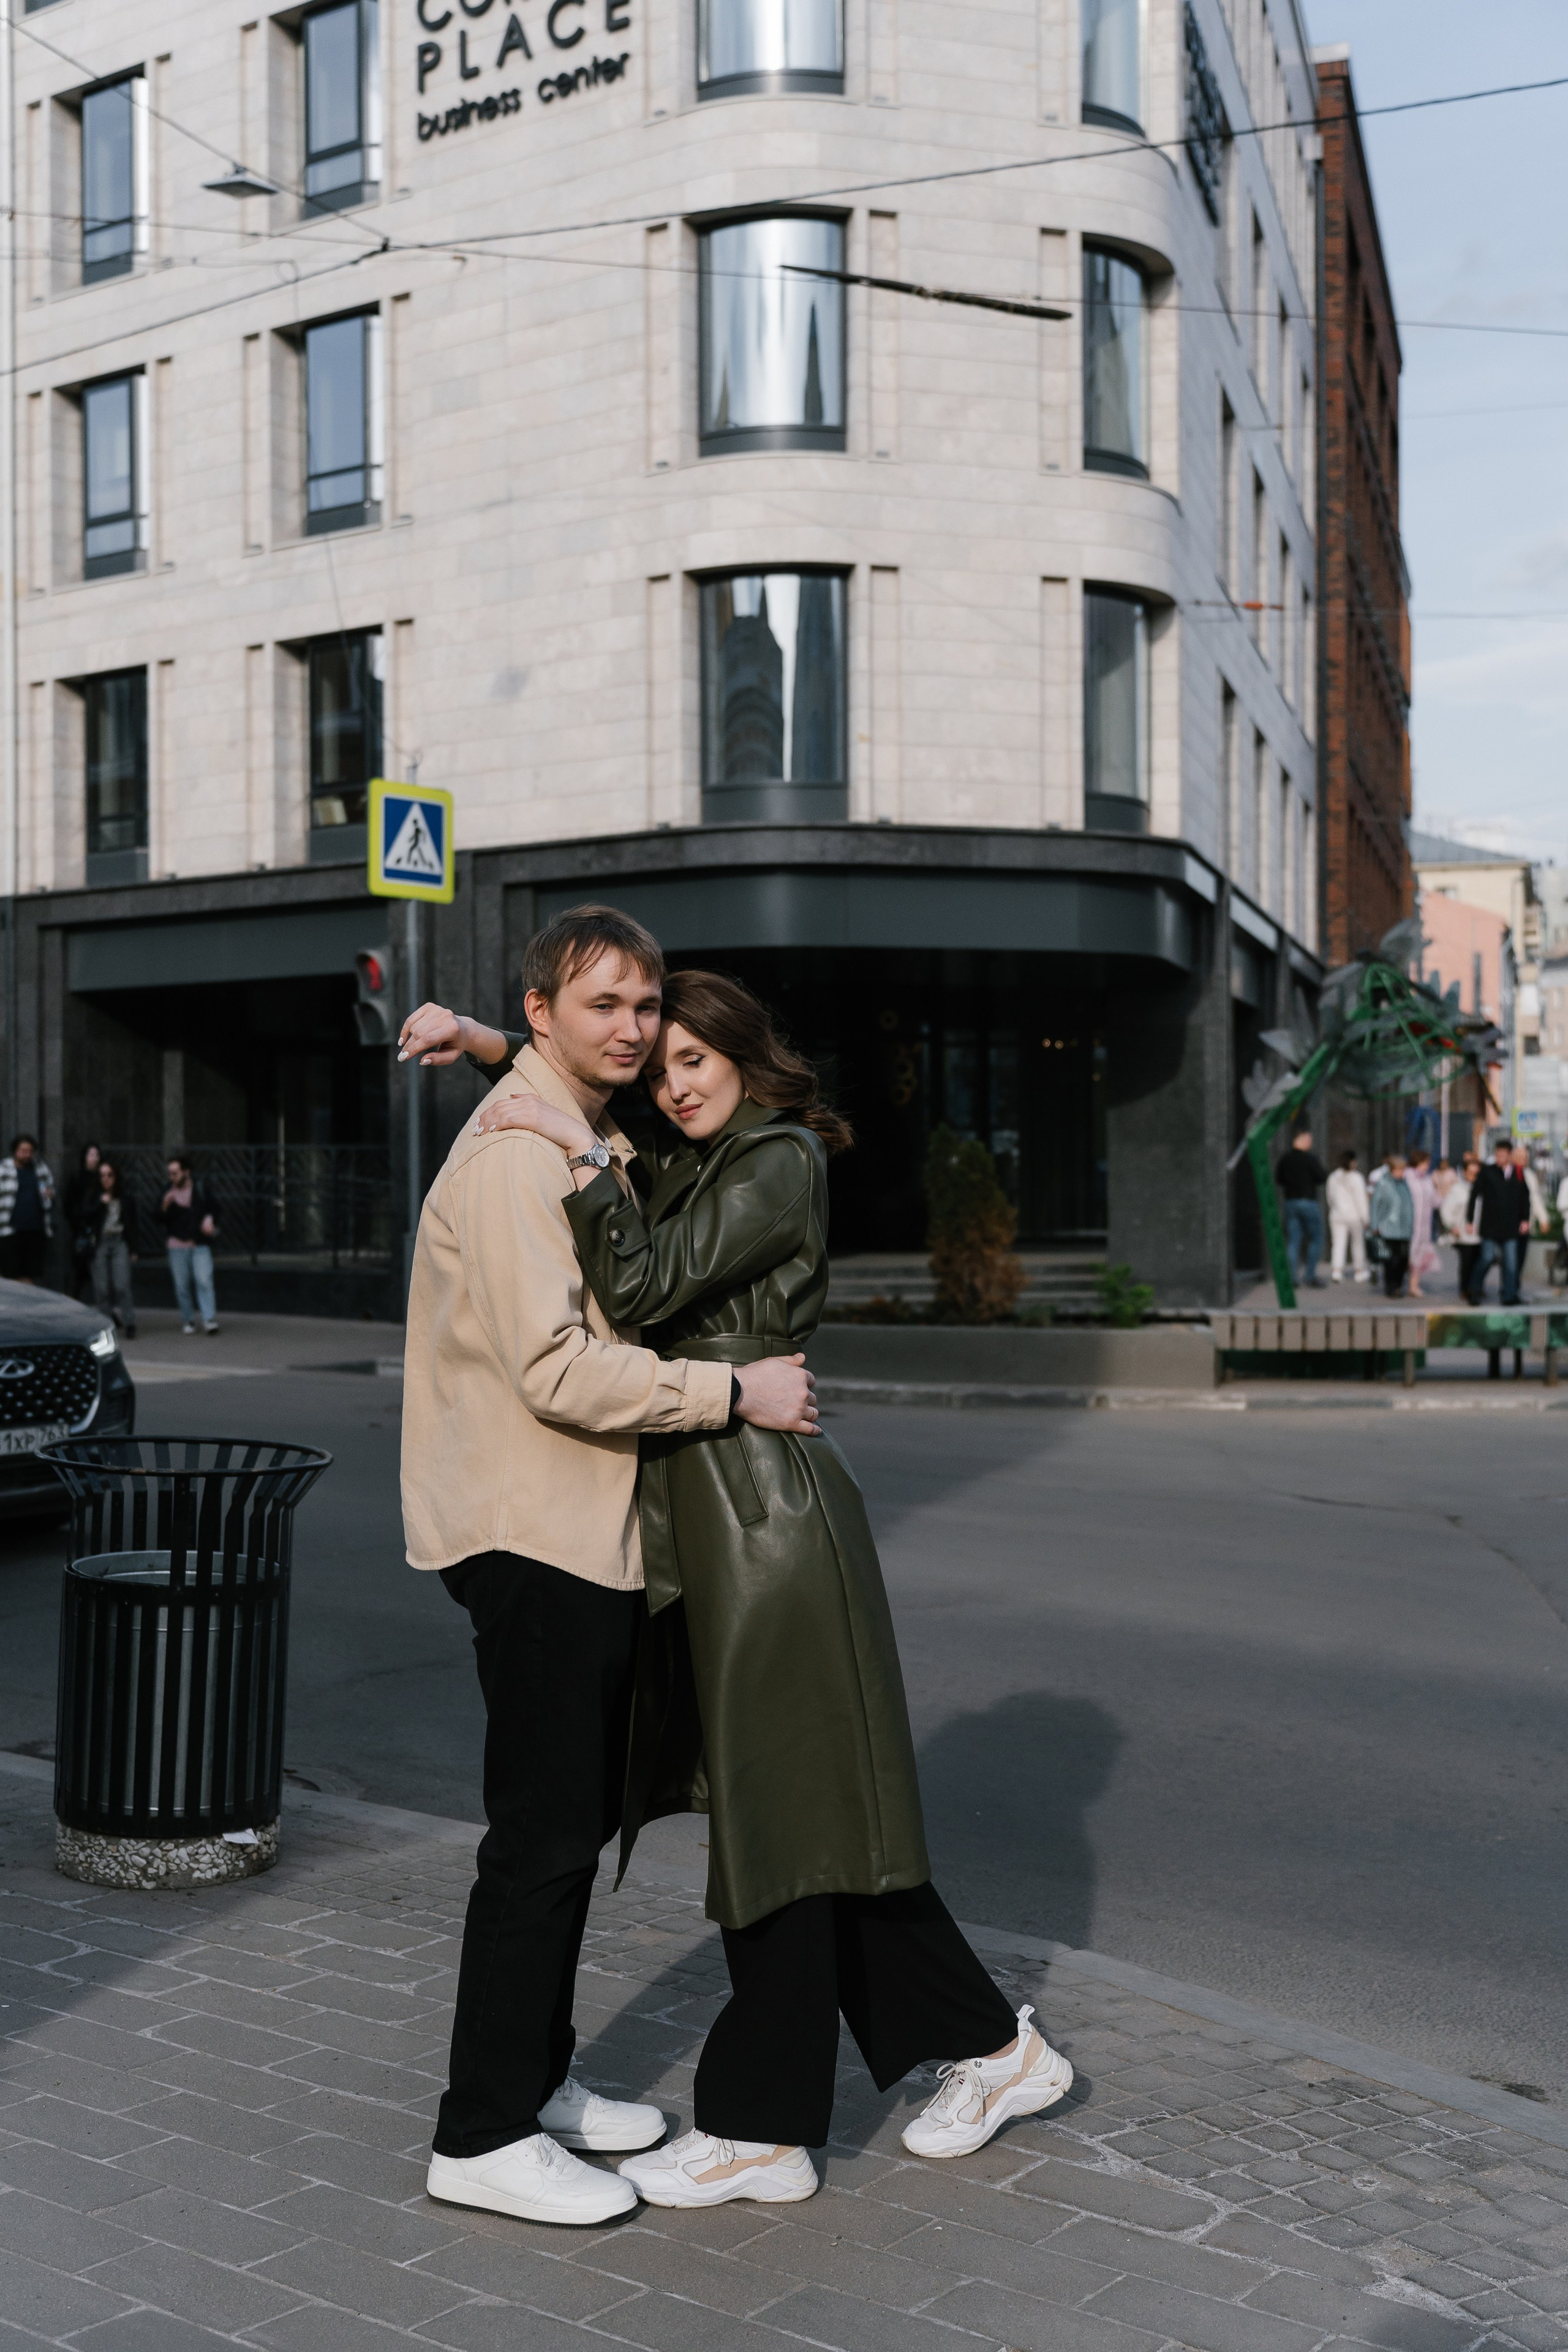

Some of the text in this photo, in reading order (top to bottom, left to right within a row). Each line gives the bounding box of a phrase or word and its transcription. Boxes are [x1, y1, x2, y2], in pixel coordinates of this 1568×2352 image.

[417, 0, 630, 94] PLACE
[417, 53, 630, 142] business center
